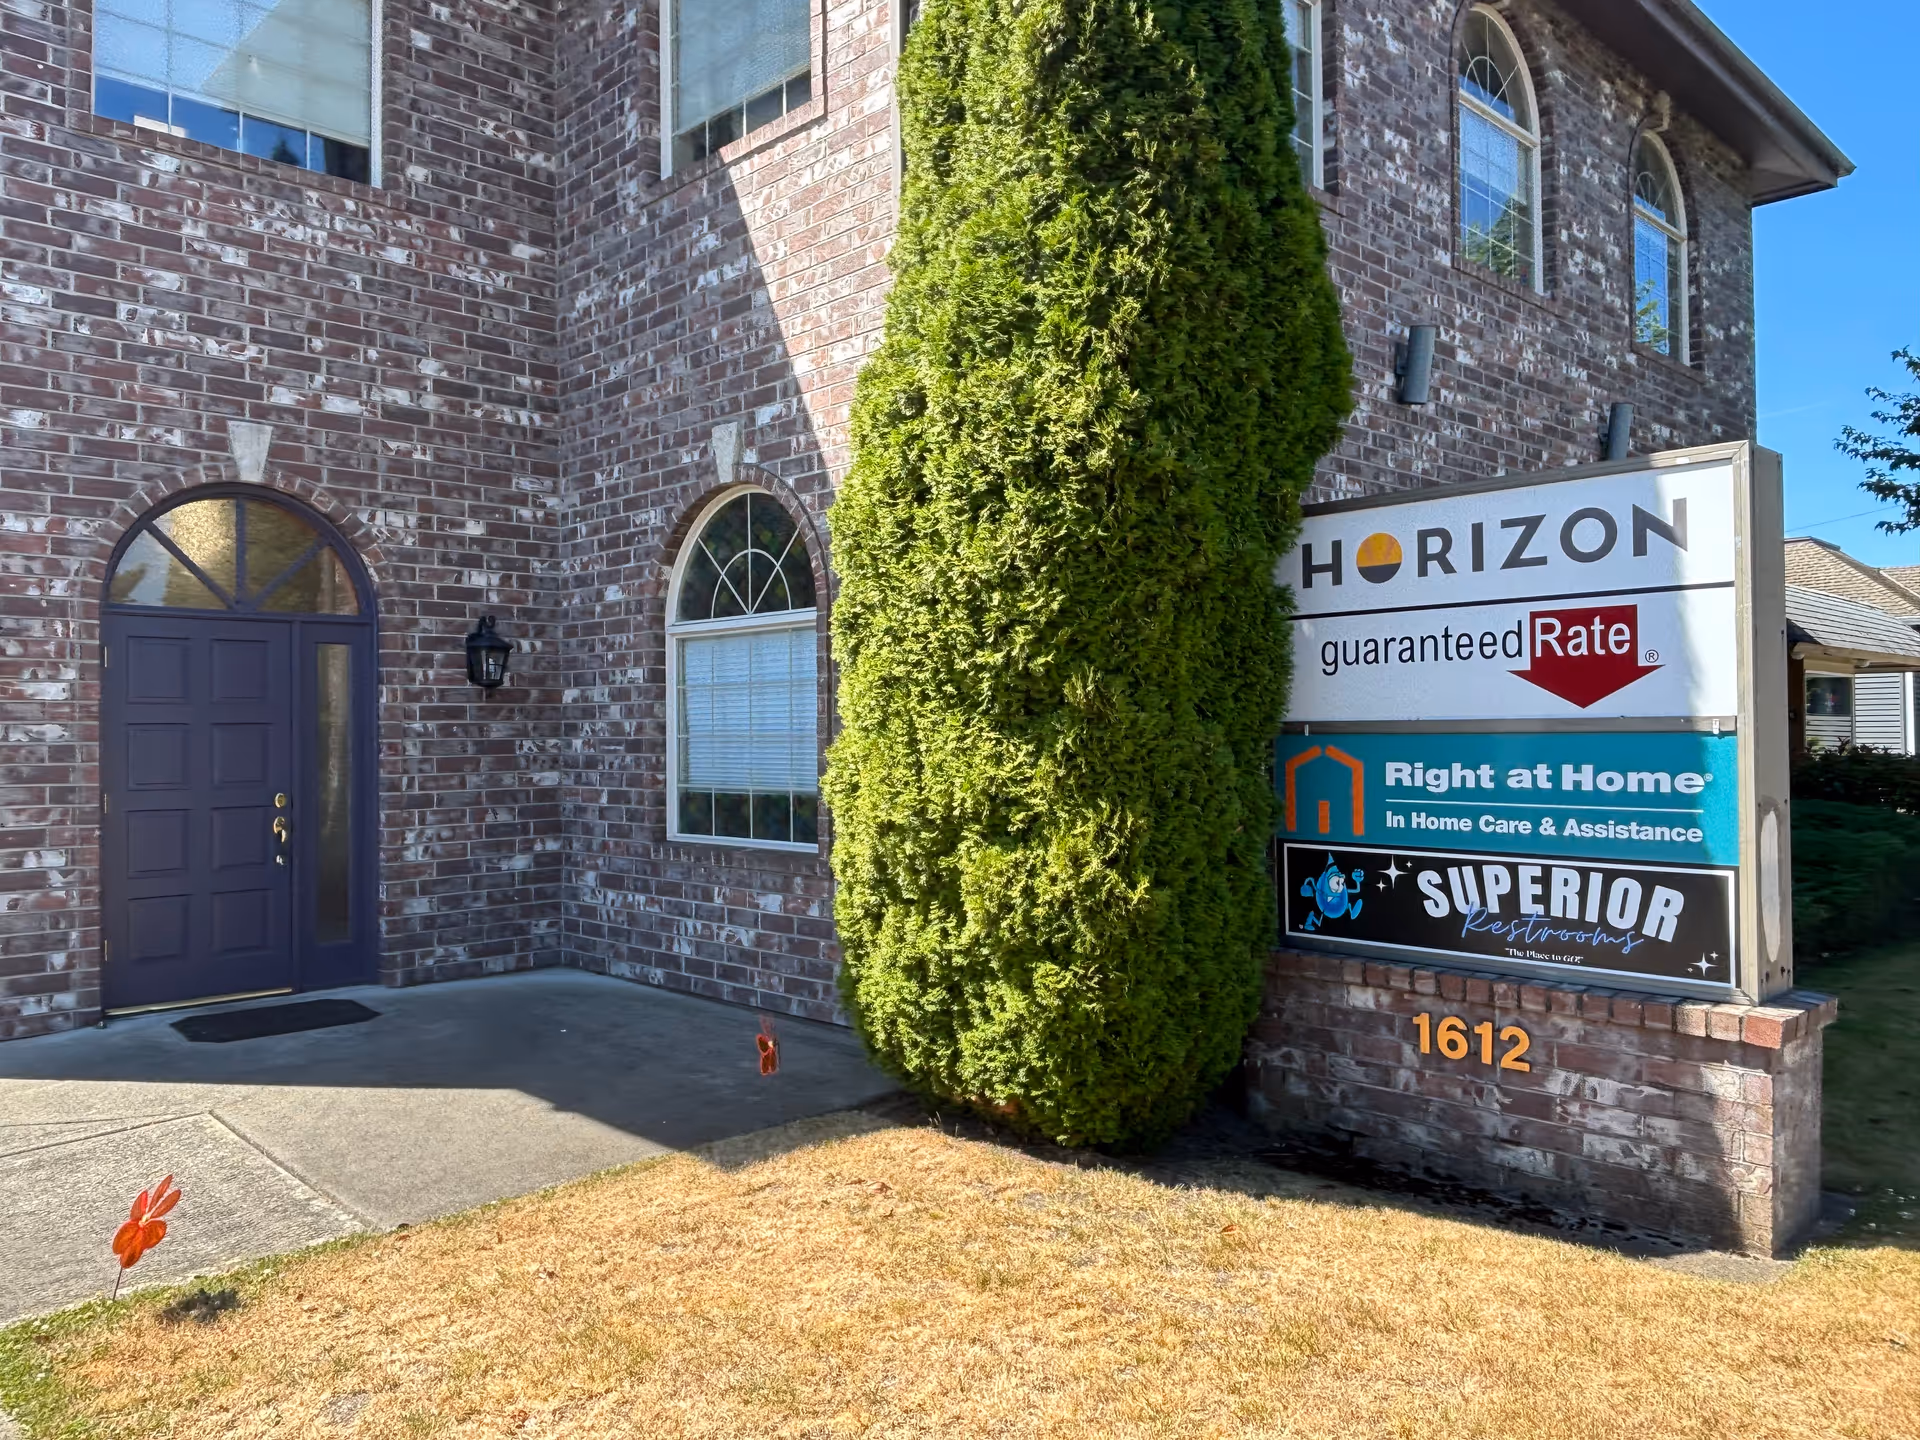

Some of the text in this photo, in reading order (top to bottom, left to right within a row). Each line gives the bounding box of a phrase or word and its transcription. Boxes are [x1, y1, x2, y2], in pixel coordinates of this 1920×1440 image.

[1301, 497, 1688, 589] HORIZON
[1321, 619, 1524, 677] guaranteed
[1535, 615, 1632, 658] Rate
[1385, 761, 1495, 793] Right
[1506, 763, 1553, 789] at
[1385, 810, 1704, 843] In Home Care & Assistance
[1416, 864, 1685, 943] SUPERIOR
[1460, 900, 1645, 954] Restrooms
[1526, 949, 1551, 961] Place
[1412, 1012, 1531, 1073] 1612
